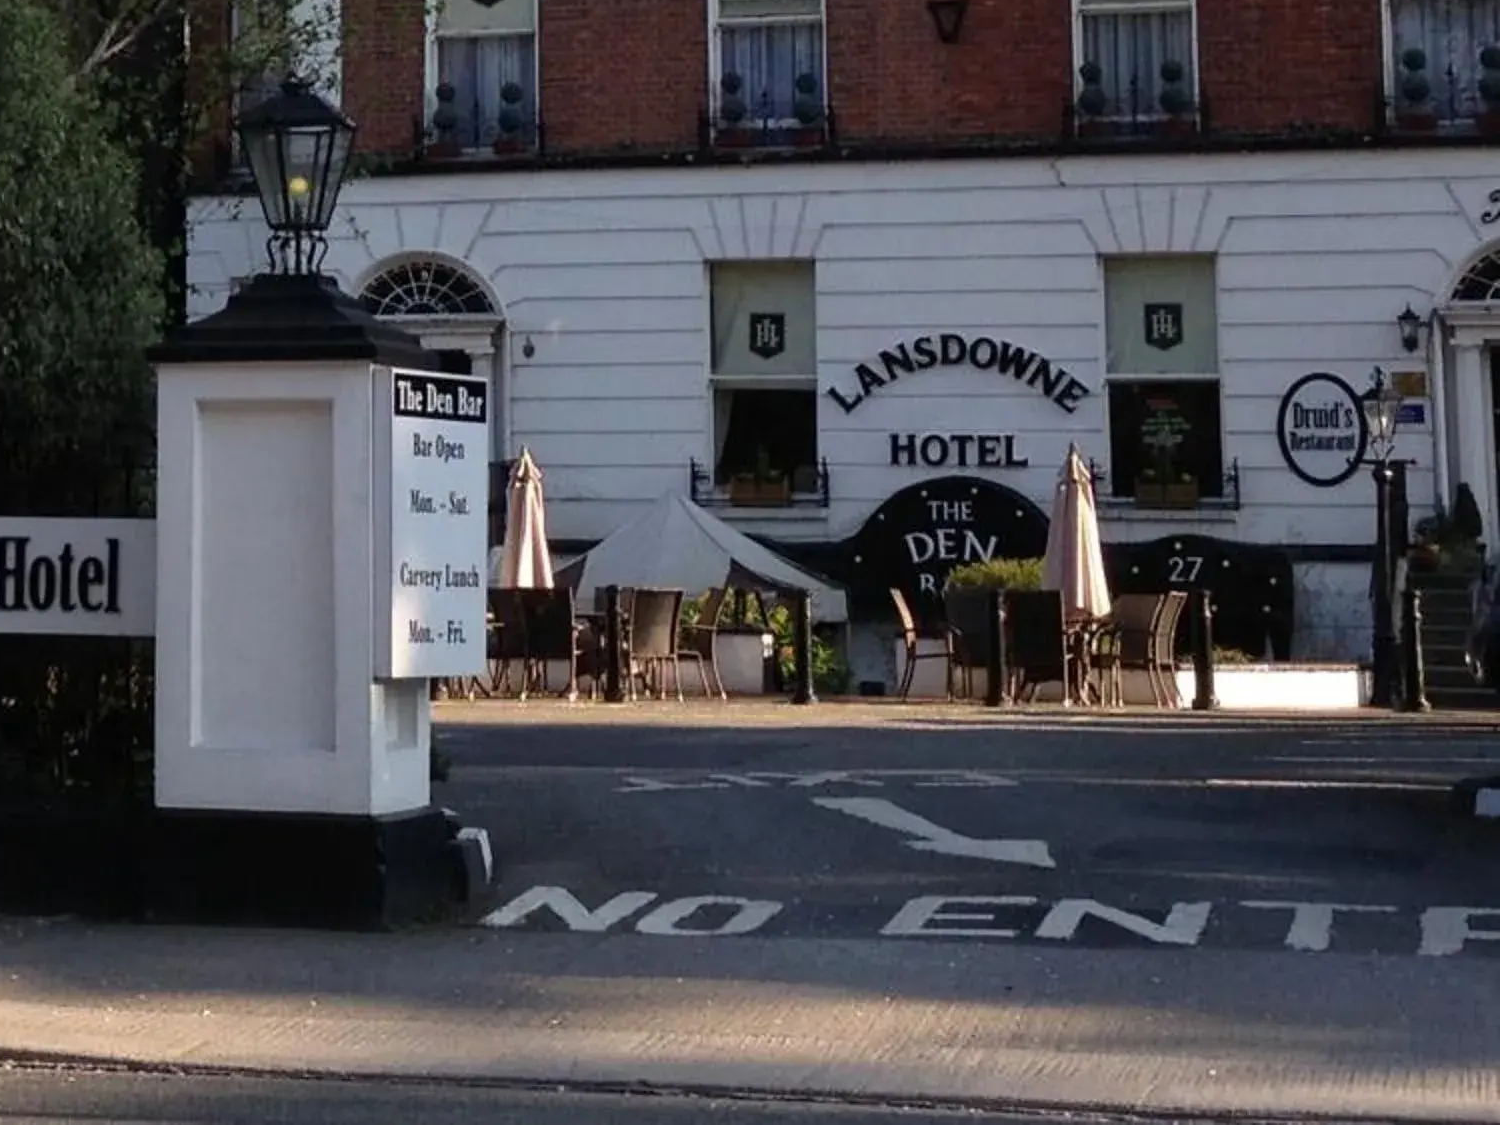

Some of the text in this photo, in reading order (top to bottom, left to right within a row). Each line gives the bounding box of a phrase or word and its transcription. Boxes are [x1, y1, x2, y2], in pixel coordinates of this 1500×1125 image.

[827, 333, 1090, 415] LANSDOWNE
[397, 380, 484, 417] The Den Bar
[1293, 401, 1353, 429] Druid's
[413, 432, 465, 463] Bar Open
[889, 432, 1029, 468] HOTEL
[1290, 431, 1355, 451] Restaurant
[926, 500, 974, 522] THE
[904, 528, 998, 564] DEN
[400, 561, 479, 592] Carvery Lunch
[1168, 556, 1203, 583] 27
[480, 886, 783, 936] NO
